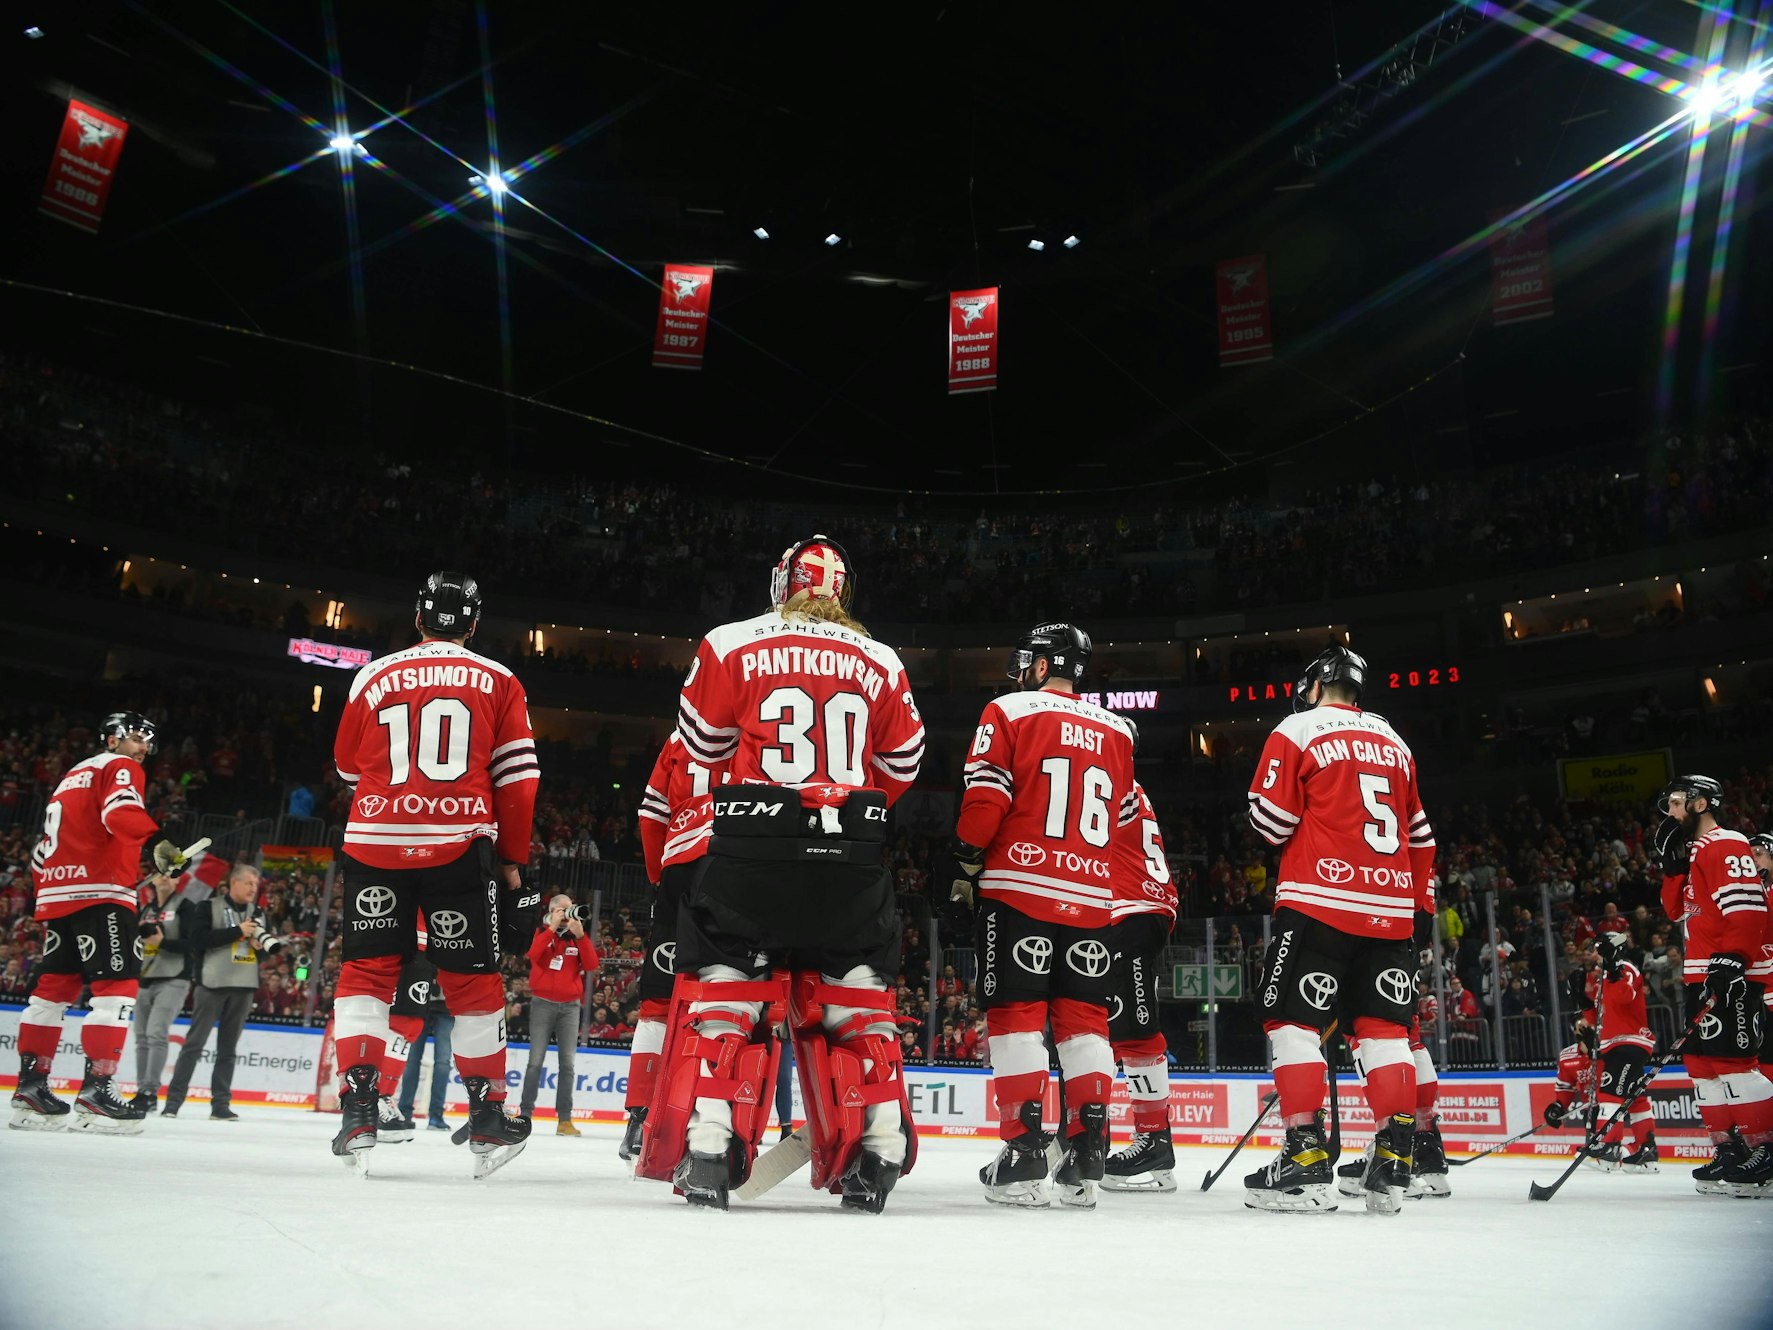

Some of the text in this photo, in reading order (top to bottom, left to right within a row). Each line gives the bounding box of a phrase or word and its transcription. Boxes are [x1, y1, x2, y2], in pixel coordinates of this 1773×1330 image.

[55, 178, 100, 207] 1986
[1500, 279, 1544, 299] 2002
[662, 307, 705, 319] Deutscher
[664, 319, 700, 330] Meister
[1226, 326, 1264, 343] 1995
[662, 334, 699, 348] 1987
[952, 332, 995, 343] Deutscher
[956, 345, 990, 354] Meister
[955, 358, 991, 372] 1988
[424, 599, 434, 610] 10
[462, 606, 472, 616] 10
[755, 623, 875, 655] STAHLWERK
[1031, 623, 1070, 636] STETSON
[341, 650, 369, 664] HAIE
[1053, 656, 1065, 666] 16
[741, 646, 884, 703] PANTKOWSKI
[364, 665, 494, 711] MATSUMOTO
[1230, 682, 1293, 702] PLAY
[1106, 691, 1158, 710] NOW
[377, 696, 472, 787] 10
[759, 686, 870, 787] 30
[971, 723, 995, 757] 16
[1060, 721, 1105, 756] BAST
[1309, 739, 1351, 769] VAN
[115, 768, 131, 786] 9
[1262, 758, 1281, 790] 5
[1591, 764, 1638, 778] Radio
[1599, 781, 1635, 794] Köln
[392, 793, 488, 816] TOYOTA
[713, 801, 784, 817] CCM
[1041, 757, 1113, 848] 16
[1710, 798, 1721, 807] 39
[1358, 772, 1401, 855] 5
[44, 799, 62, 860] 9
[1724, 855, 1758, 878] 39
[107, 911, 121, 954] TOYOTA
[352, 917, 400, 932] TOYOTA
[490, 906, 501, 963] TOYOTA
[986, 911, 997, 969] TOYOTA
[1269, 930, 1294, 984] TOYOTA
[1134, 956, 1146, 1005] TOYOTA
[1618, 1063, 1632, 1086] TOYOTA
[907, 1081, 964, 1115] ETL
[1192, 1090, 1215, 1099] Haie
[1468, 1096, 1500, 1107] HAIE!
